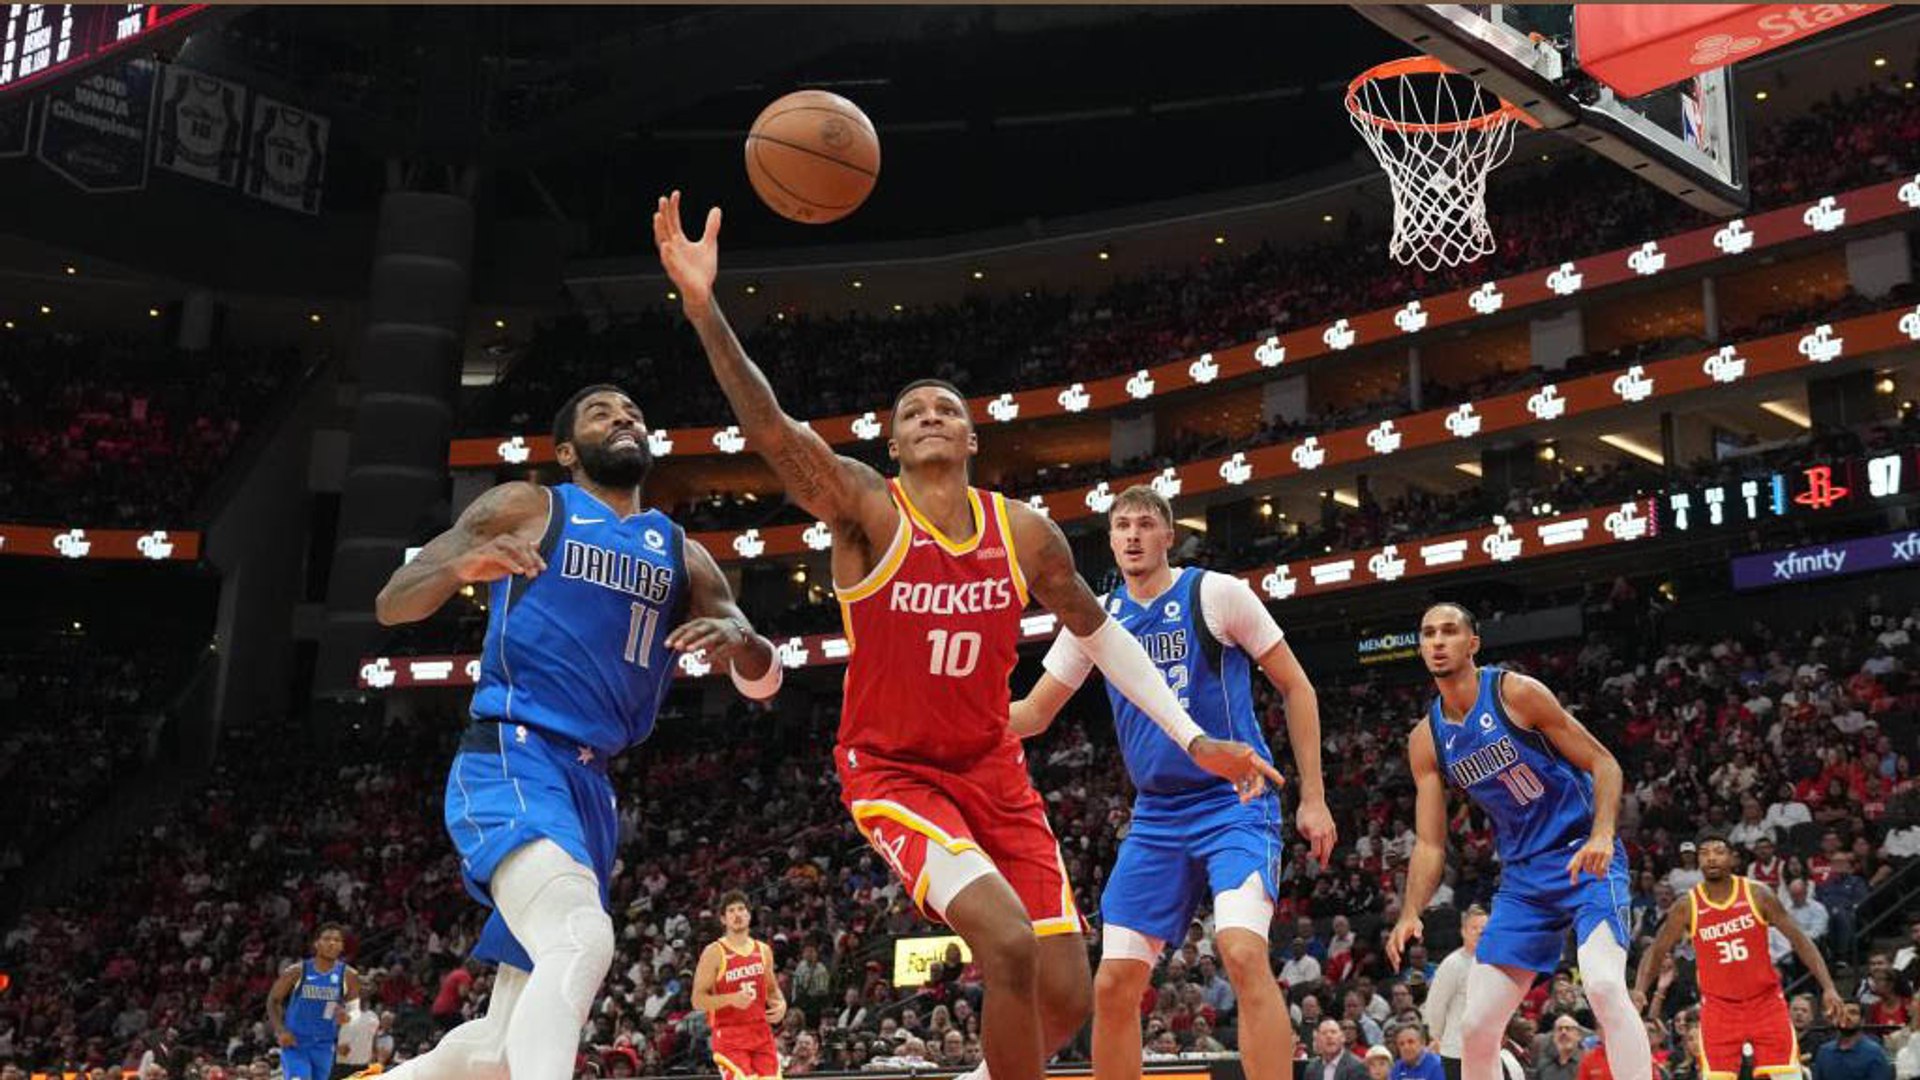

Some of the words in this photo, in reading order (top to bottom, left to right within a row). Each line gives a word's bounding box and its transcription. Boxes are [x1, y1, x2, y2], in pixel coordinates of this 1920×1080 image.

[1758, 4, 1866, 39] Sta
[75, 87, 130, 117] WNBA
[1867, 455, 1901, 497] 97
[562, 539, 674, 603] DALLAS
[1772, 547, 1846, 580] xfinity
[890, 578, 1011, 614] ROCKETS
[624, 602, 659, 669] 11
[927, 629, 982, 677] 10
[1358, 632, 1417, 653] MEMORIAL
[1161, 665, 1190, 708] 2
[1448, 735, 1518, 789] DALLAS
[1496, 762, 1545, 806] 10
[1699, 913, 1755, 942] ROCKETS
[1715, 939, 1749, 964] 36
